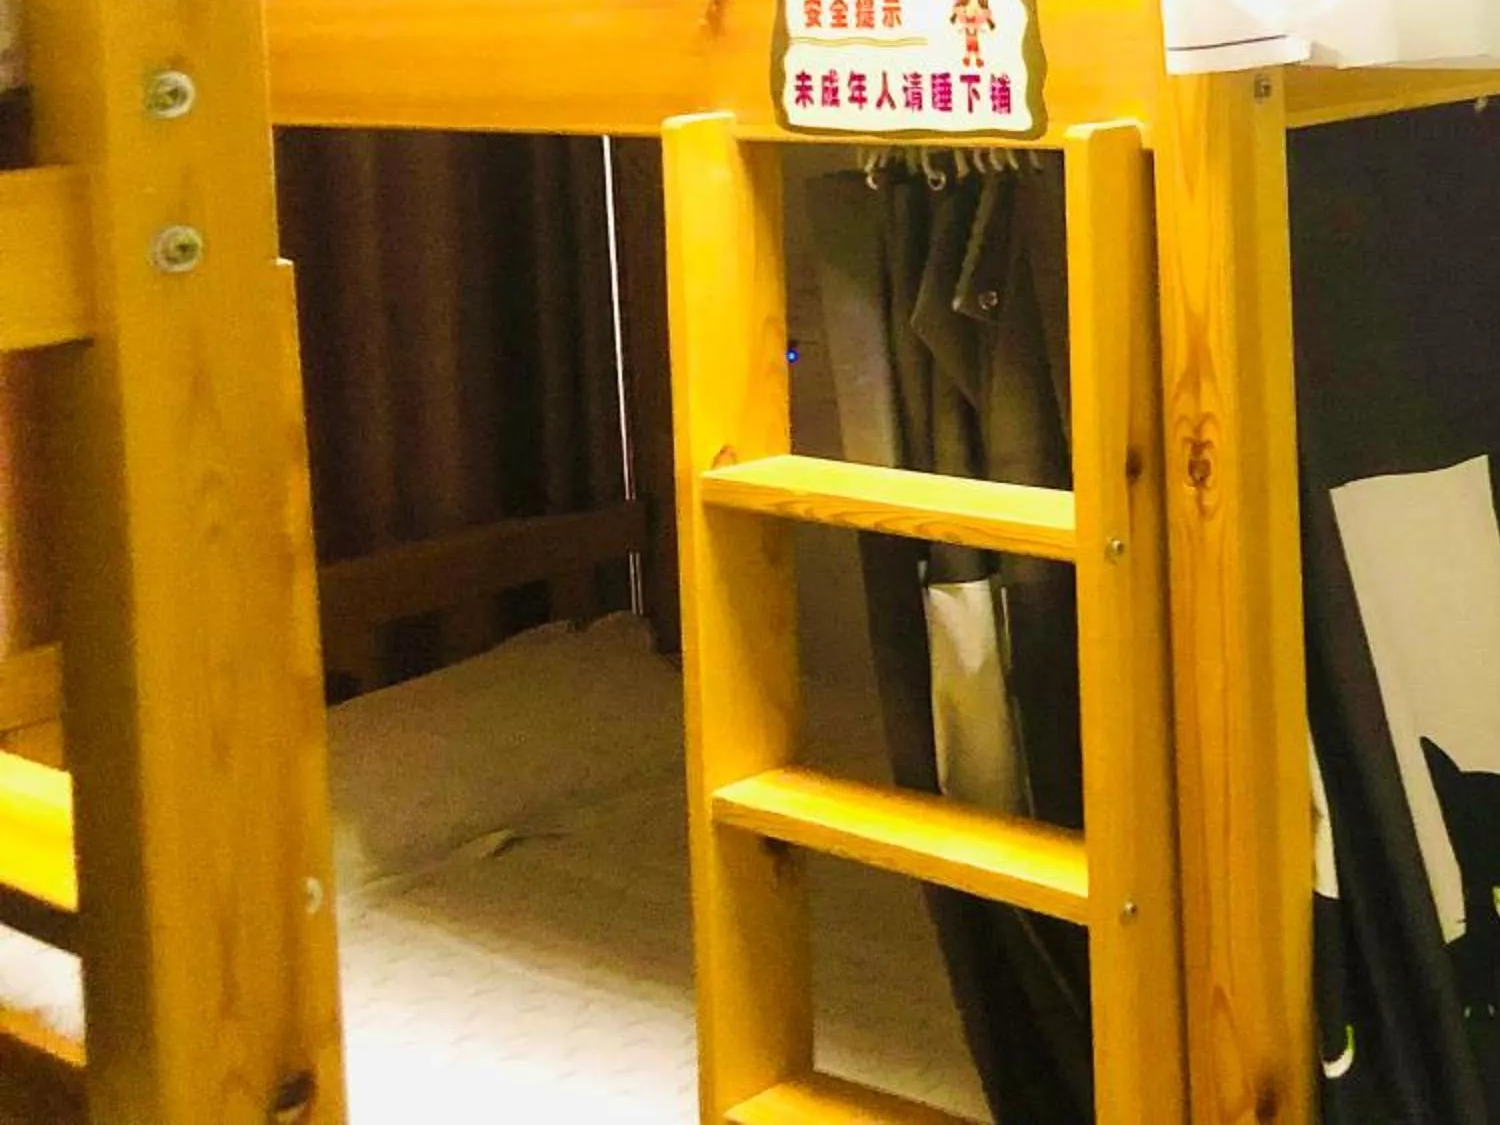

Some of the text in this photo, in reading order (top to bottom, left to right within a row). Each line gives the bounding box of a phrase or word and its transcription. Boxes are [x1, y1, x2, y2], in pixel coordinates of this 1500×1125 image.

[794, 69, 1012, 115] 未成年人请睡下铺
